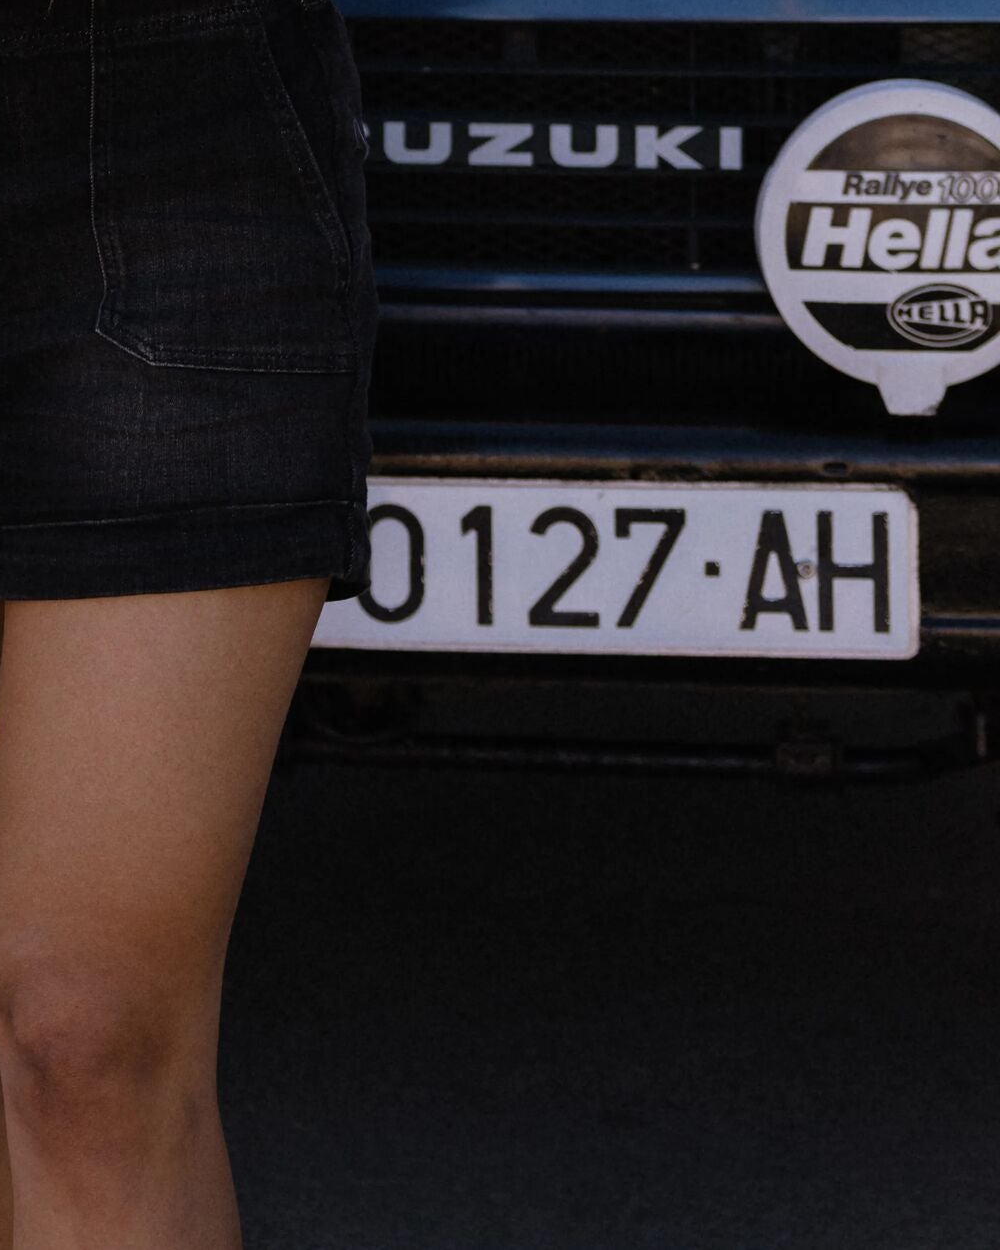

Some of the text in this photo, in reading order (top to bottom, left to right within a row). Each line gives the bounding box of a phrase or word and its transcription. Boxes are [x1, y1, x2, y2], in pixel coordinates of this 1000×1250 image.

[362, 121, 742, 170] UZUKI
[842, 172, 1000, 205] Rallye 100
[801, 206, 1000, 272] Hella
[897, 300, 989, 327] HELLA
